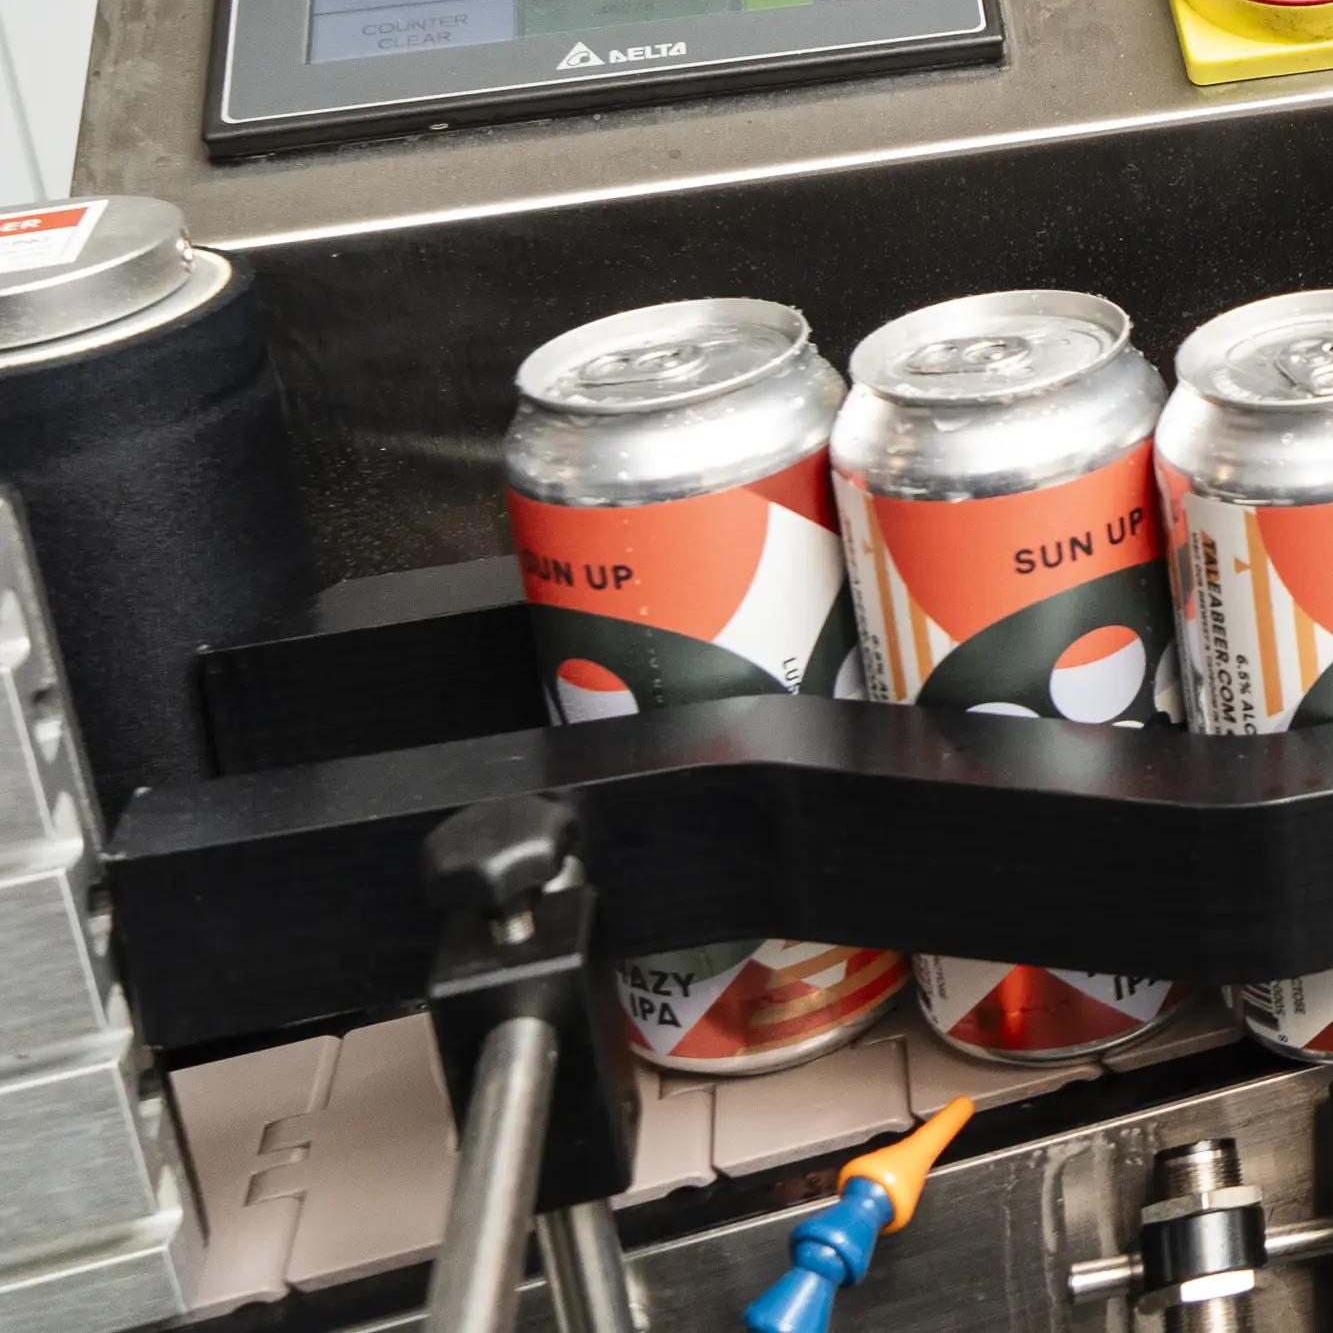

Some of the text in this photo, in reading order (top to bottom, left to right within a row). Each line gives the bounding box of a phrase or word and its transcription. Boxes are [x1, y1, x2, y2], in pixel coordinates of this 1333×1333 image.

[362, 14, 469, 36] COUNTER
[377, 31, 451, 49] CLEAR
[609, 41, 687, 64] DELTA
[1015, 506, 1145, 574] SUN UP
[522, 549, 634, 592] SUN UP
[1202, 540, 1236, 723] TALEABEER.COM
[1235, 654, 1253, 695] 6.5%
[629, 992, 683, 1028] IPA
